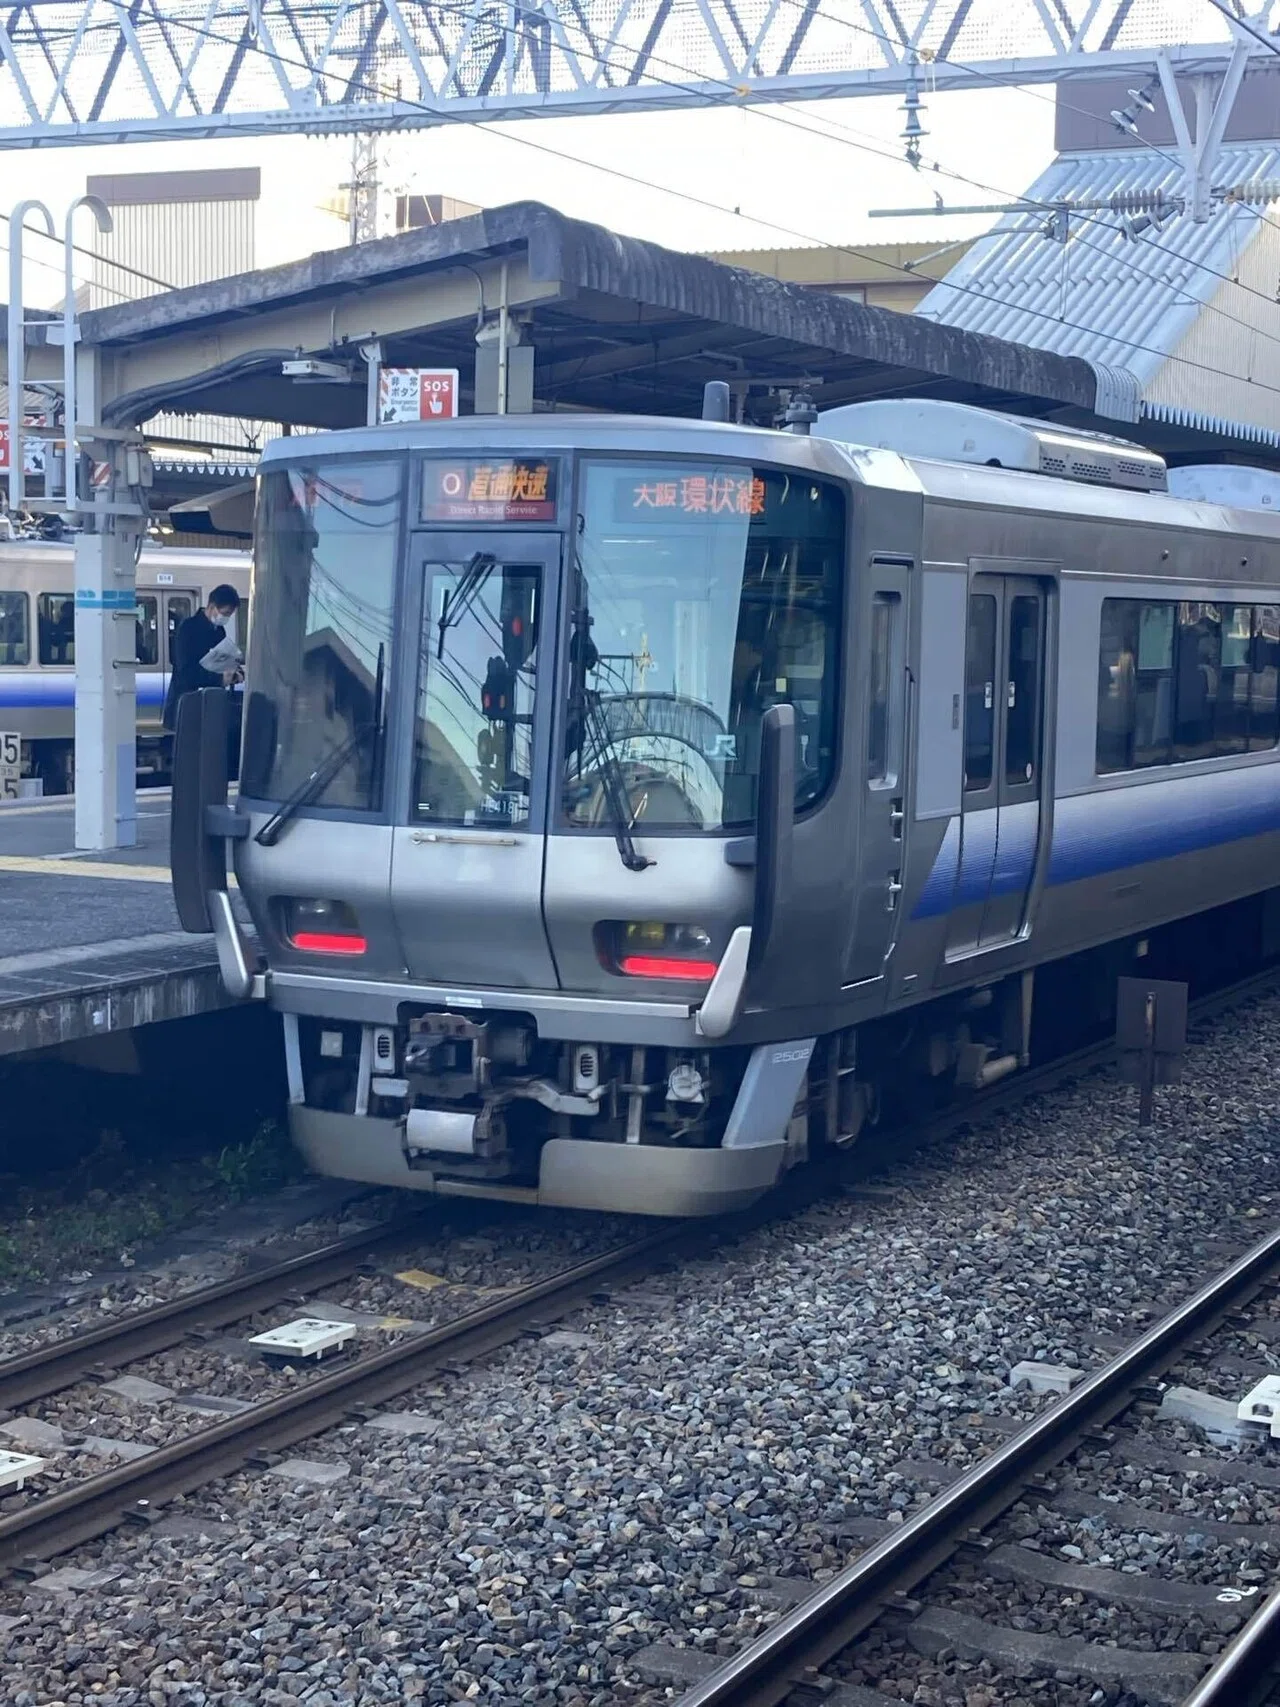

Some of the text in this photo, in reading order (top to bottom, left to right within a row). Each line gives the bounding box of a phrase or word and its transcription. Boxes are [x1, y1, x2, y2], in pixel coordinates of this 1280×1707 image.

[391, 388, 418, 397] ボタン
[424, 381, 450, 392] SOS
[467, 465, 549, 501] 直通快速
[478, 505, 503, 515] Rapid
[505, 505, 537, 514] Service
[702, 734, 736, 757] JR
[772, 1048, 810, 1064] 2502
